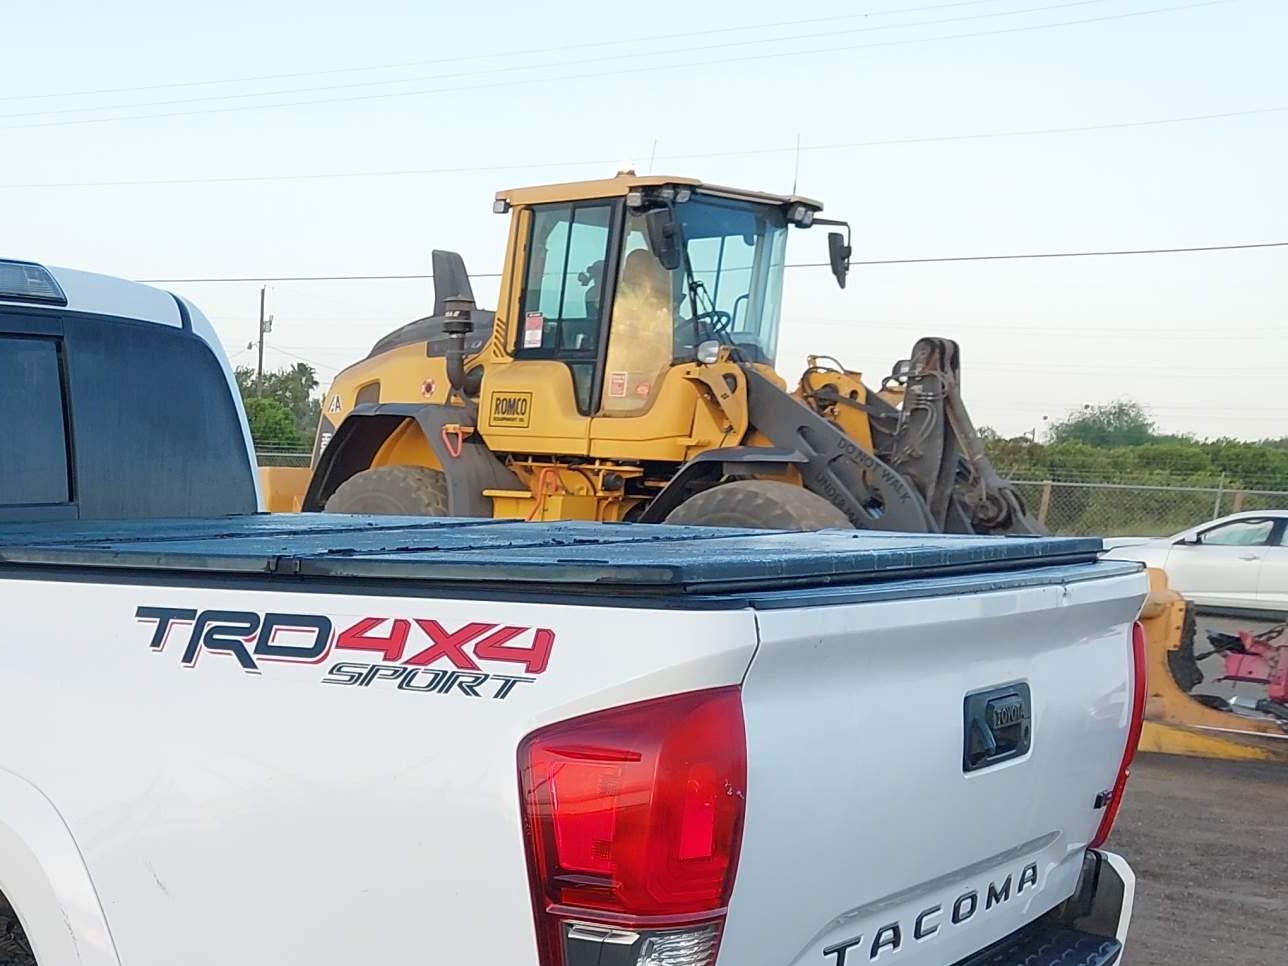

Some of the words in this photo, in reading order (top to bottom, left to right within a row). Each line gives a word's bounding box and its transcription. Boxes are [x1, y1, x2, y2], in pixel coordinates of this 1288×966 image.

[494, 397, 528, 416] ROMCO
[837, 438, 856, 455] DO
[880, 468, 911, 504] WALK
[135, 605, 336, 675] TRD
[321, 661, 537, 700] SPORT
